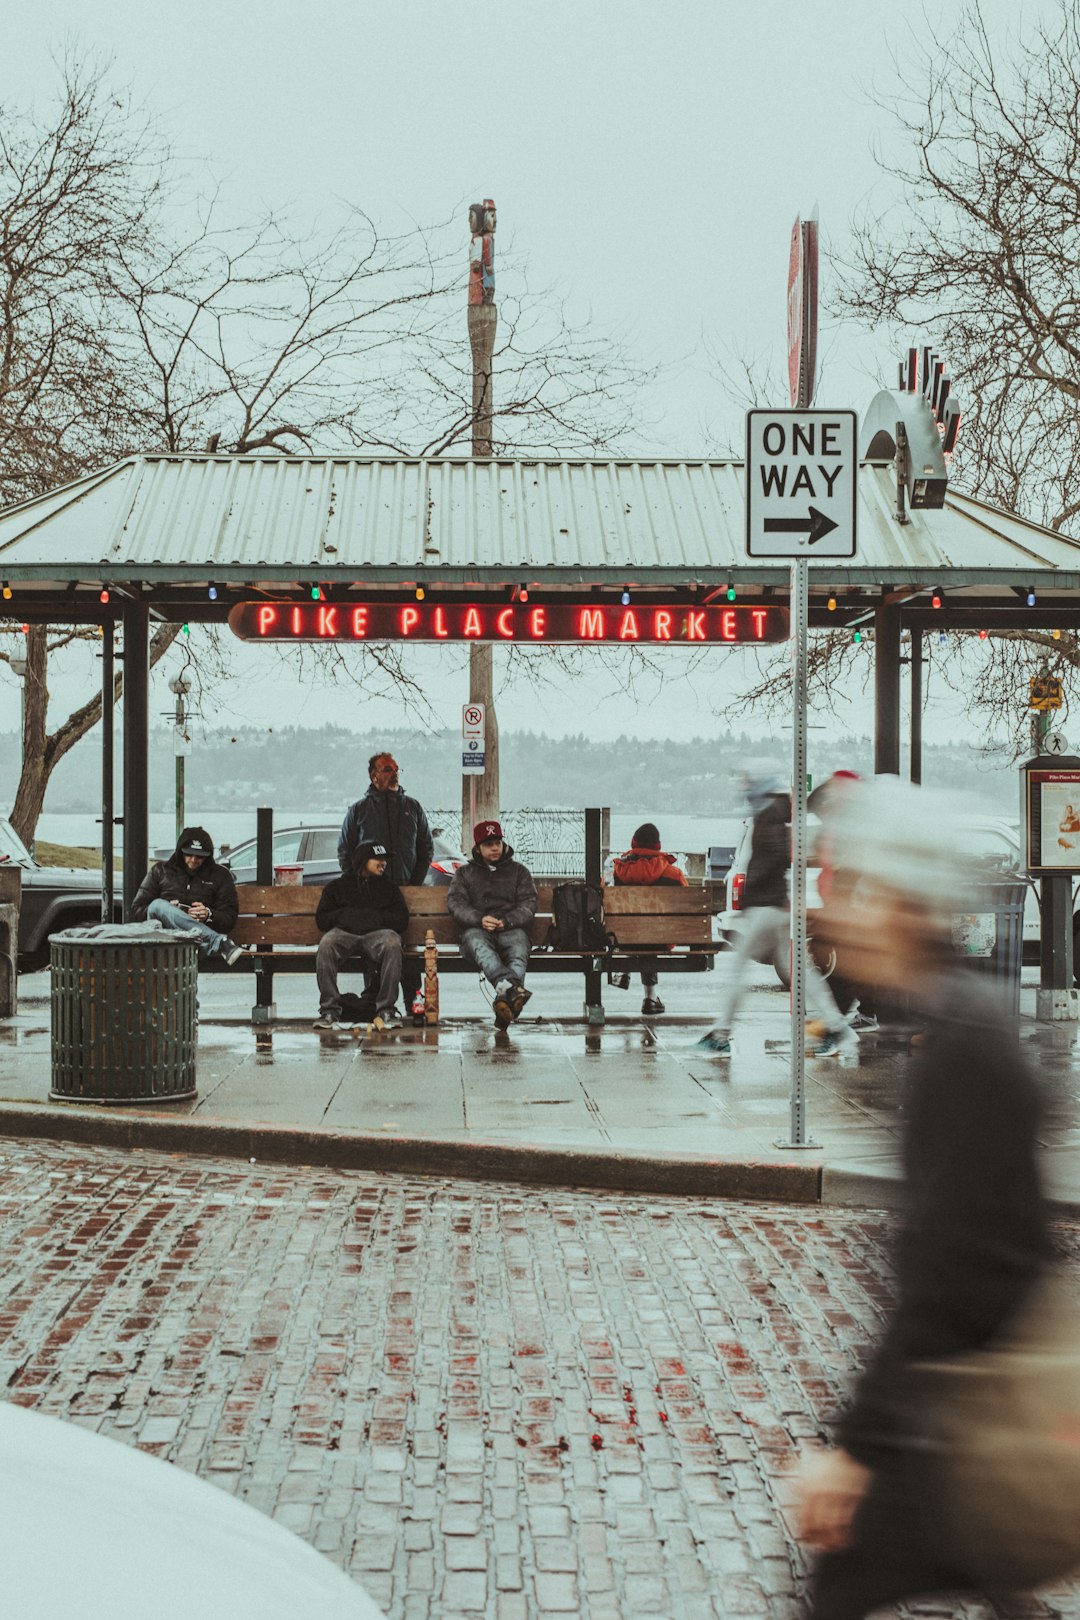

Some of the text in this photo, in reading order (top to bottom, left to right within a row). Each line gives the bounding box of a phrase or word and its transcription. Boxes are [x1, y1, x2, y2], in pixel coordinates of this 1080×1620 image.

[763, 422, 841, 456] ONE
[760, 465, 844, 497] WAY
[258, 606, 767, 640] PIKE PLACE MARKET
